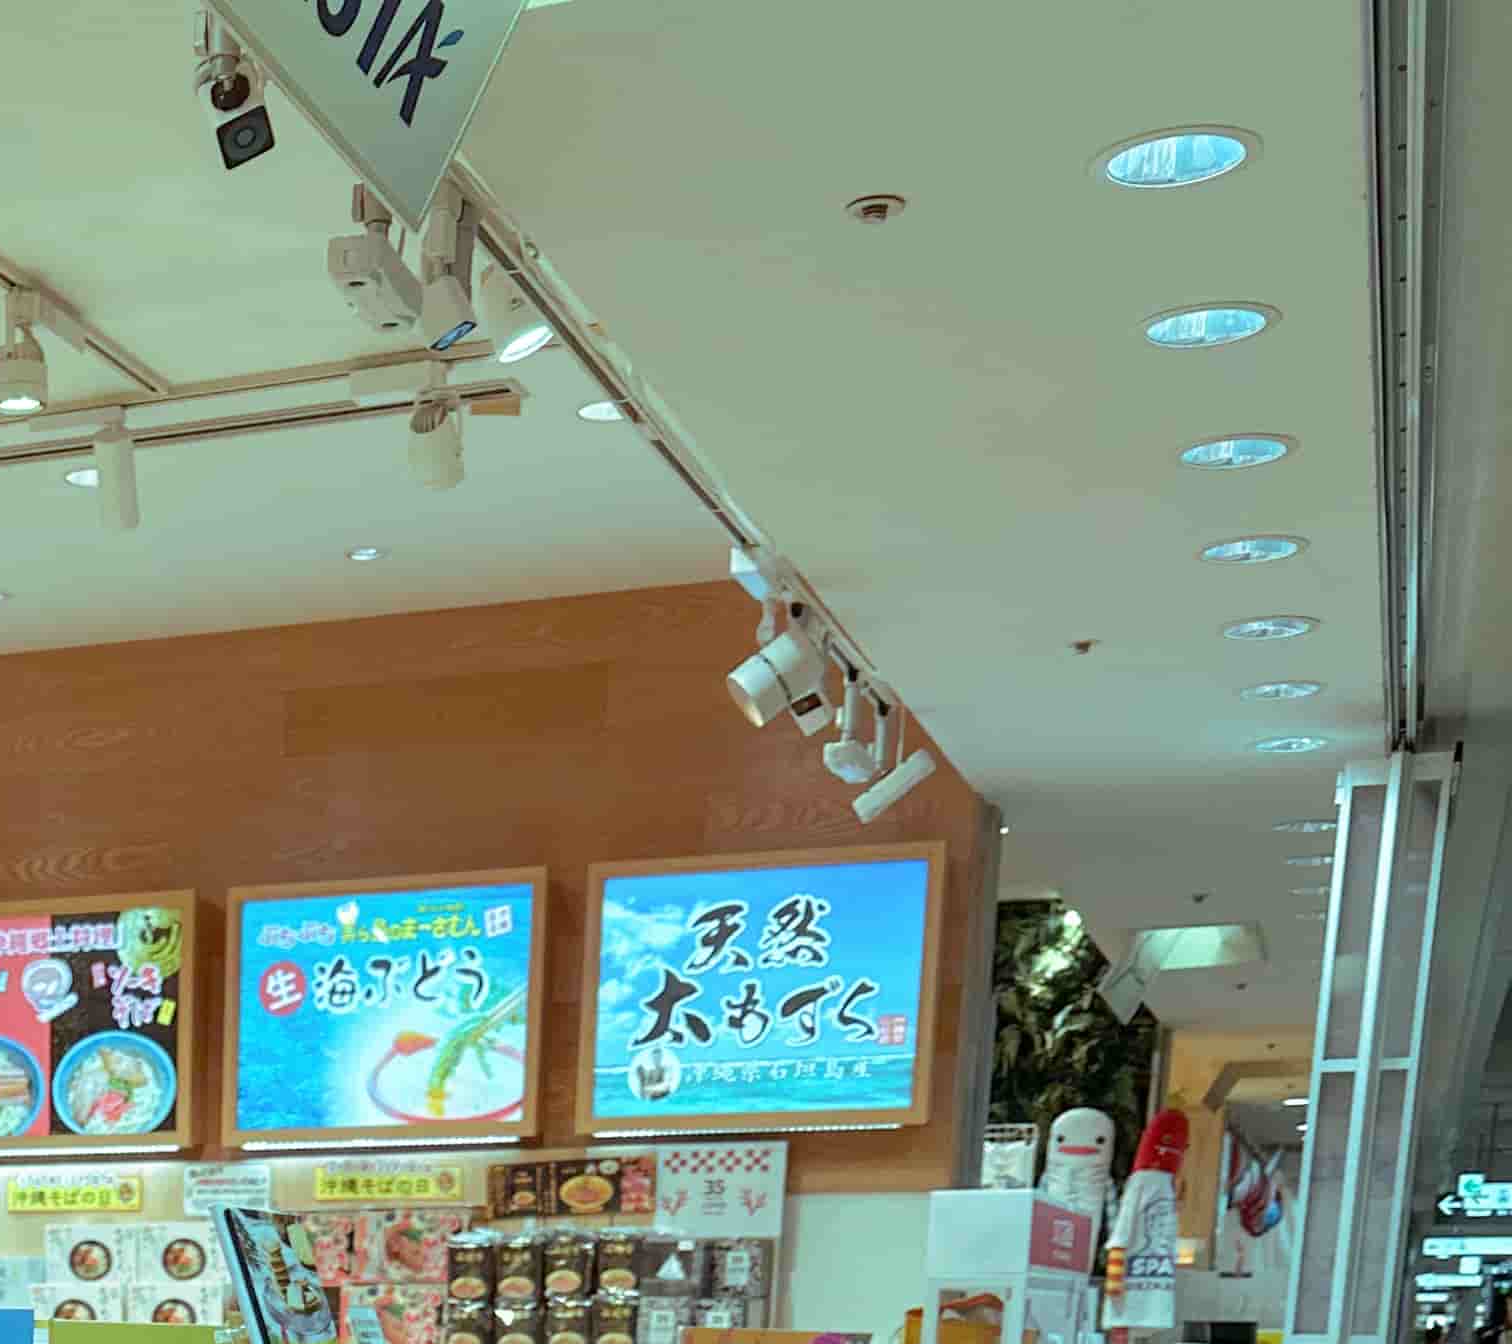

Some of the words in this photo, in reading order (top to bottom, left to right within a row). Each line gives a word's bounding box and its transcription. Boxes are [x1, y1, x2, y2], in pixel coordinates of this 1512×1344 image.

[687, 896, 828, 970] 天然
[266, 968, 304, 1011] 生
[314, 949, 487, 1011] 海ぶどう
[631, 966, 879, 1047] 太もずく
